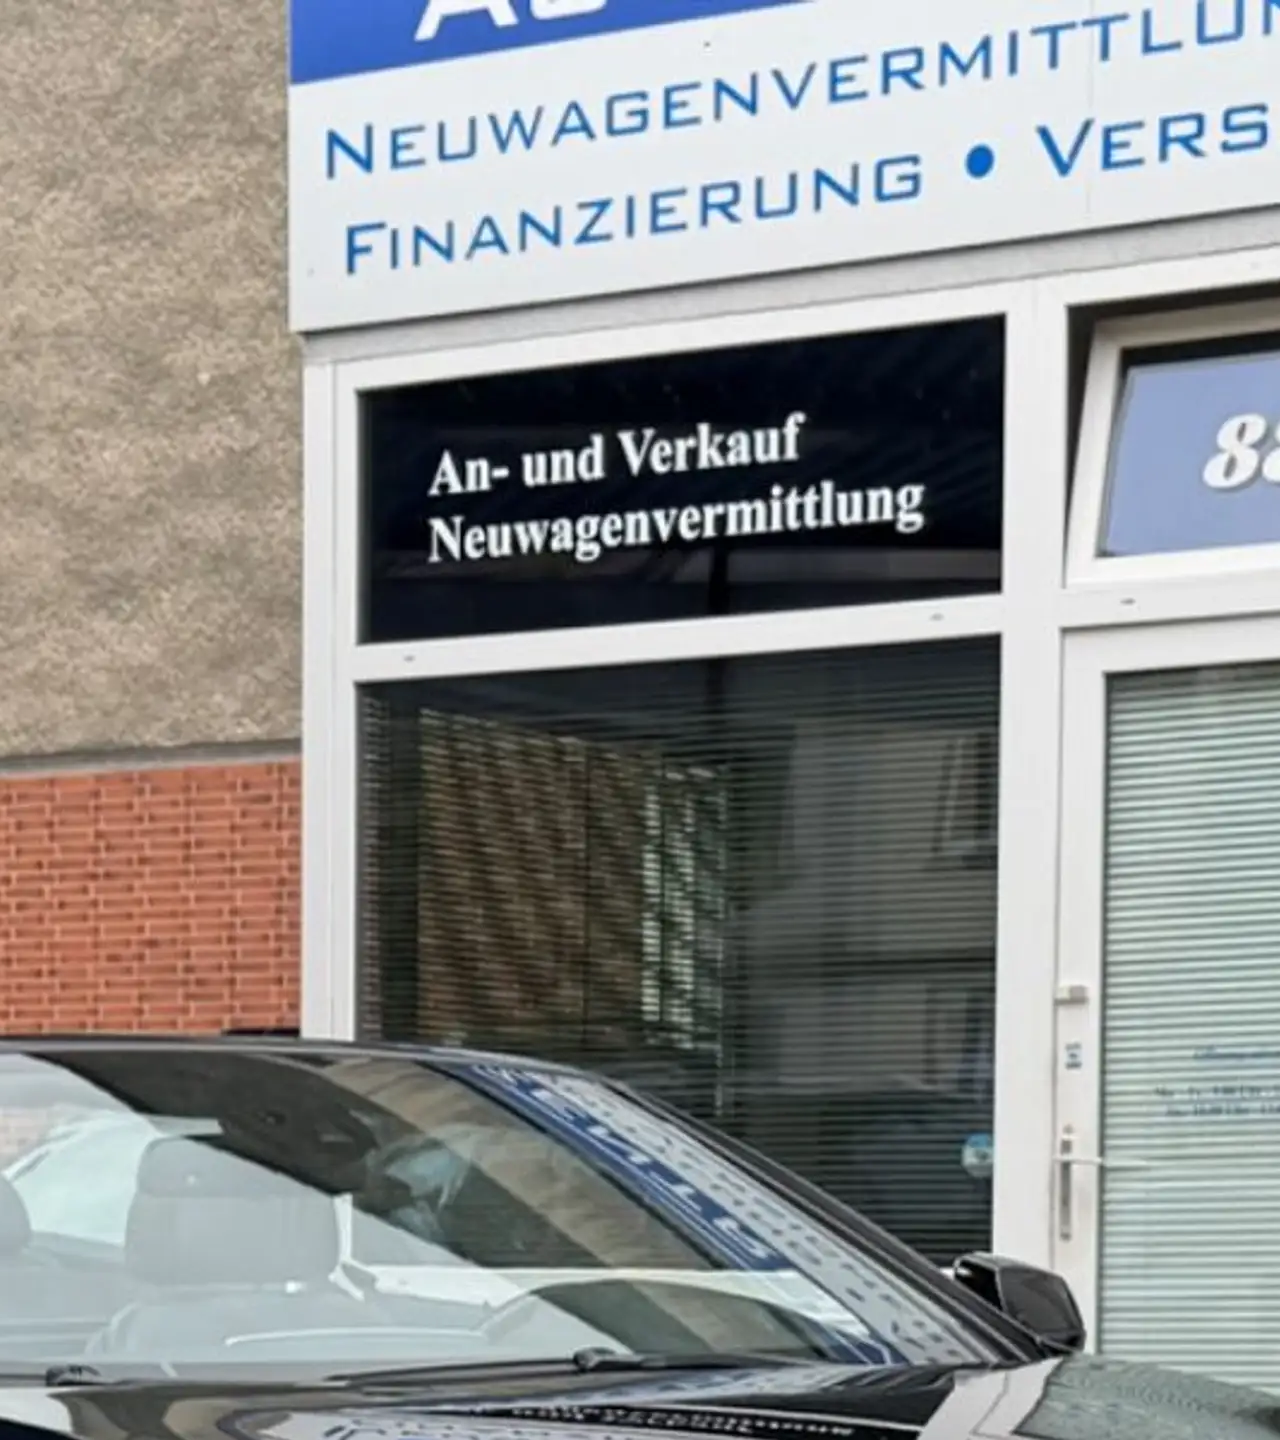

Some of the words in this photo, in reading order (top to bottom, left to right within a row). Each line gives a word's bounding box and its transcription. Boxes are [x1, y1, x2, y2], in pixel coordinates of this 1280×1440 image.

[346, 155, 921, 275] FINANZIERUNG
[427, 449, 511, 498] An-
[520, 434, 606, 488] und
[616, 411, 807, 476] Verkauf
[427, 480, 926, 564] Neuwagenvermittlung
